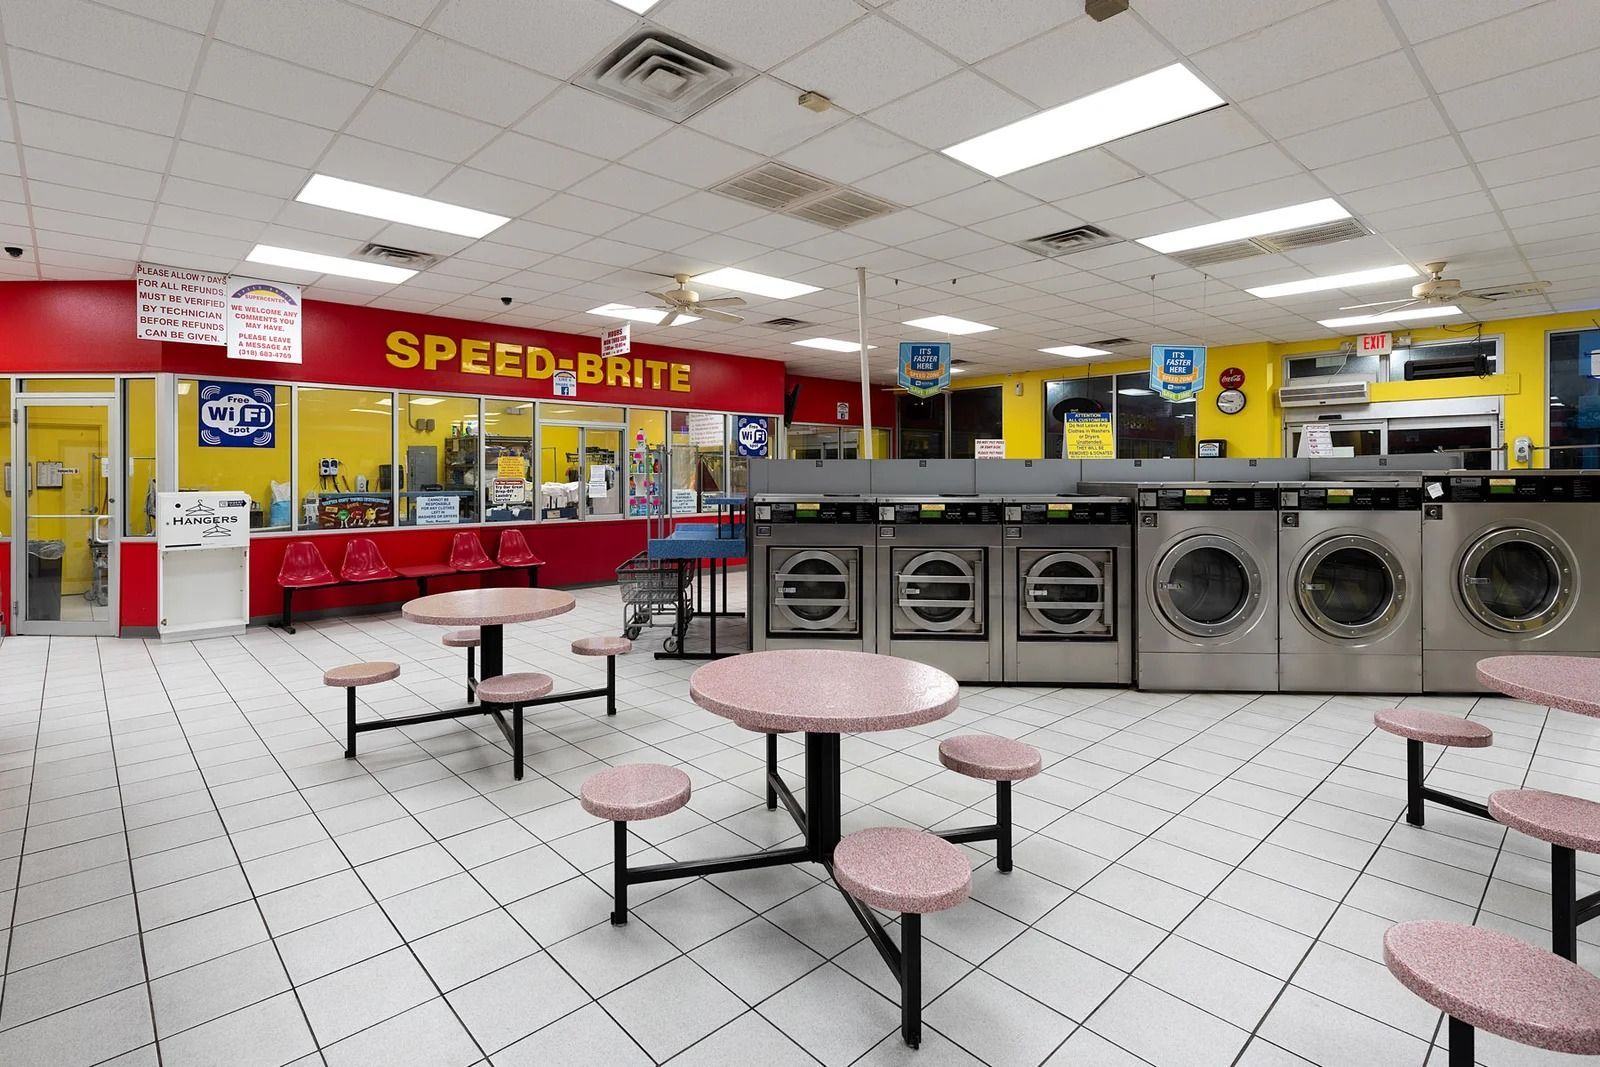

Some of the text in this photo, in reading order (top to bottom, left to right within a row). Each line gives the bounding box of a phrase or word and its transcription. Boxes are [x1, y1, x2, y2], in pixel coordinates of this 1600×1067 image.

[137, 266, 169, 278] PLEASE
[171, 271, 199, 281] ALLOW
[207, 276, 227, 285] DAYS
[138, 279, 158, 288] FOR
[161, 282, 178, 290] ALL
[139, 292, 225, 308] MUST BE VERIFIED
[245, 294, 286, 304] SUPERCENTER
[160, 306, 222, 320] TECHNICIAN
[245, 306, 282, 316] WELCOME
[140, 316, 224, 331] BEFORE REFUNDS
[235, 313, 278, 323] COMMENTS
[145, 329, 167, 337] CAN
[188, 333, 220, 342] GIVEN.
[246, 342, 280, 350] MESSAGE
[1363, 335, 1386, 350] EXIT
[386, 330, 691, 392] SPEED-BRITE
[173, 516, 238, 525] HANGERS
